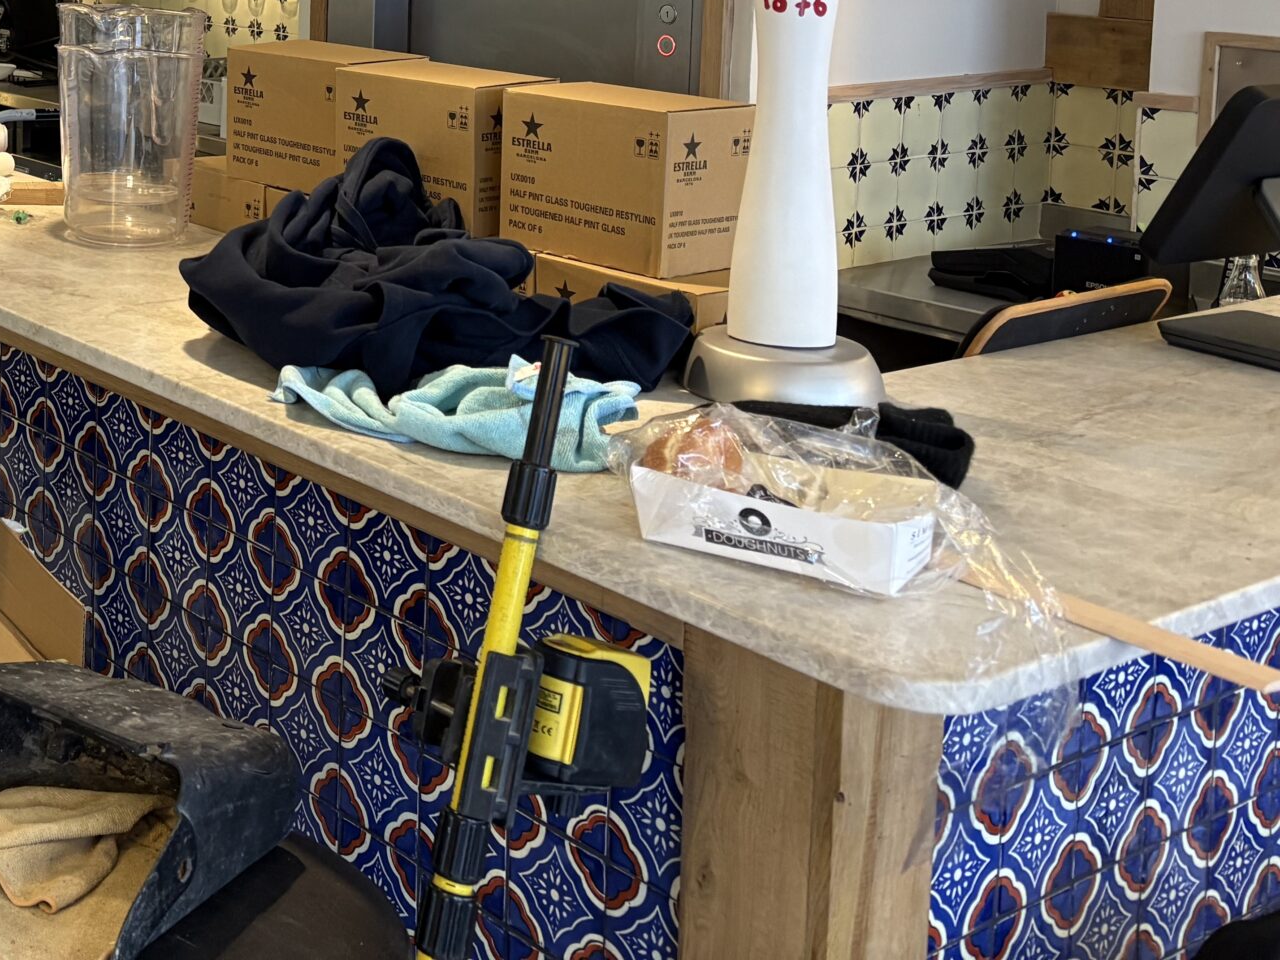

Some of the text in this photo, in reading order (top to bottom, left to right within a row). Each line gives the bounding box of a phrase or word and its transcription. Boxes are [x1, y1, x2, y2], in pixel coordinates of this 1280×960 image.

[234, 86, 264, 99] ESTRELLA
[343, 111, 378, 126] ESTRELLA
[233, 129, 336, 157] HALF PINT GLASS TOUGHENED RESTYLI
[511, 137, 552, 152] ESTRELLA
[233, 155, 246, 164] PACK
[241, 144, 273, 157] TOUGHENED
[275, 151, 287, 160] HALF
[289, 153, 300, 163] PINT
[302, 156, 320, 167] GLASS
[674, 160, 708, 172] ESTRELLA
[432, 176, 467, 192] RESTYLING
[510, 173, 535, 185] UX0010
[426, 191, 442, 201] LASS
[510, 188, 527, 199] HALF
[528, 191, 544, 202] PINT
[545, 195, 569, 208] GLASS
[570, 200, 613, 217] TOUGHENED
[616, 210, 656, 226] RESTYLING
[509, 204, 519, 213] UK
[520, 206, 563, 222] TOUGHENED
[565, 215, 582, 227] HALF
[584, 219, 599, 231] PINT
[601, 223, 625, 236] GLASS
[509, 219, 543, 234] PACK OF 6
[1086, 281, 1109, 289] EPSO
[711, 531, 806, 561] DOUGHNUTS
